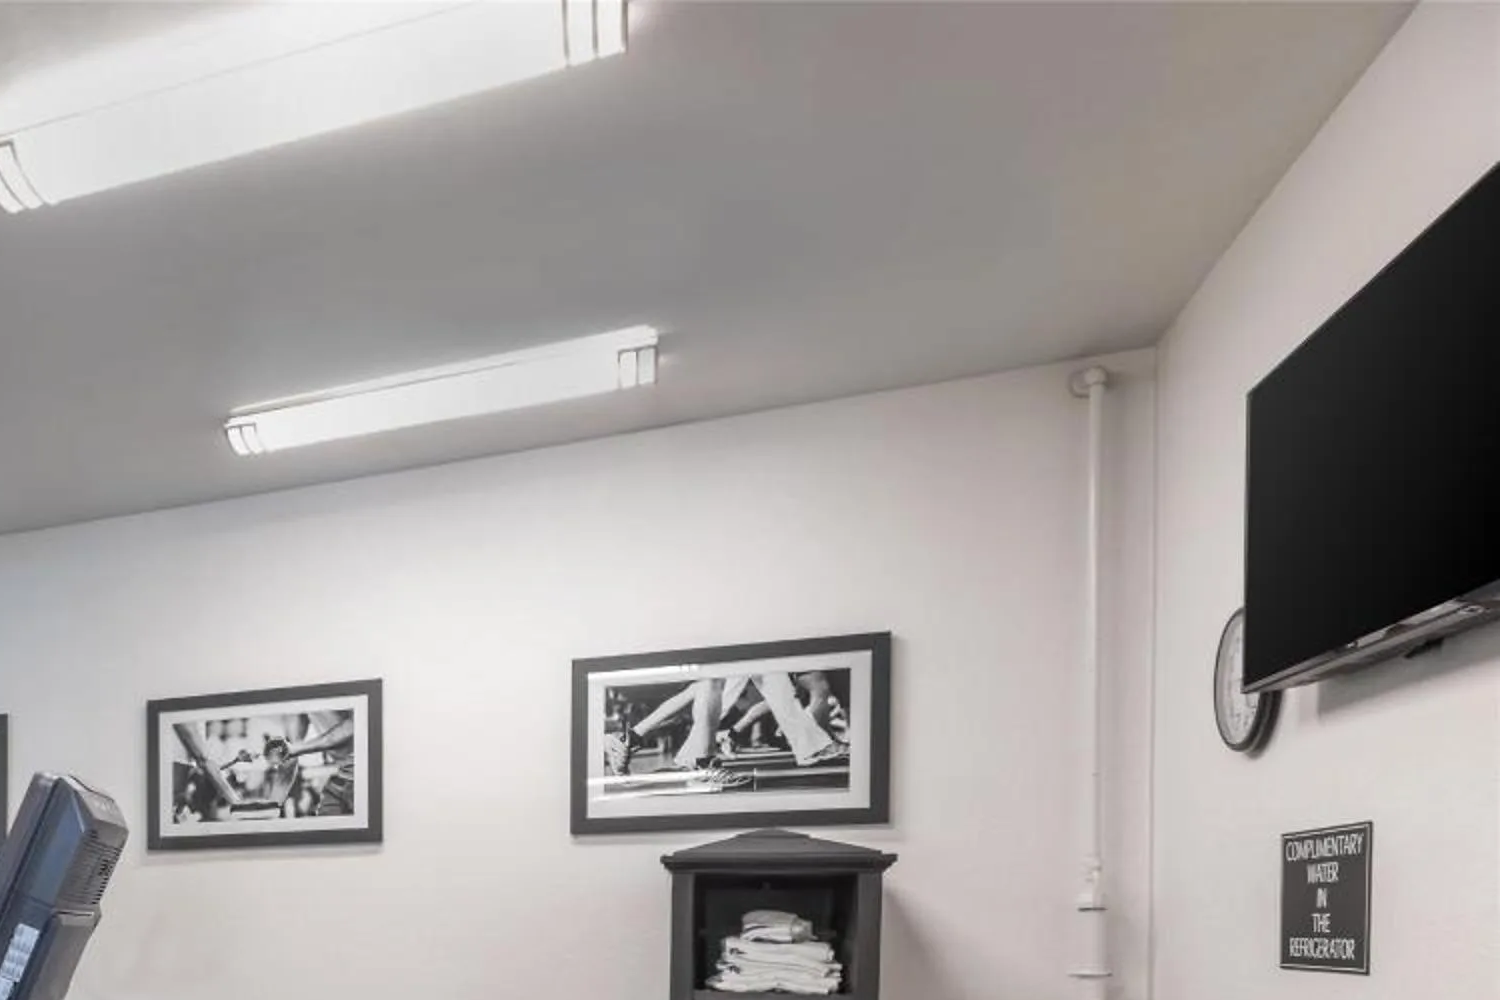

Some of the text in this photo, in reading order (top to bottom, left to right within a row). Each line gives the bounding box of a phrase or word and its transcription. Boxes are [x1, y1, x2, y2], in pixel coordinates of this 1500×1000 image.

[1286, 834, 1364, 861] COMPLIMENTARY
[1306, 862, 1339, 884] WATER
[1316, 888, 1327, 908] IN
[1311, 913, 1331, 933] THE
[1289, 937, 1355, 960] REFRIGERATOR
